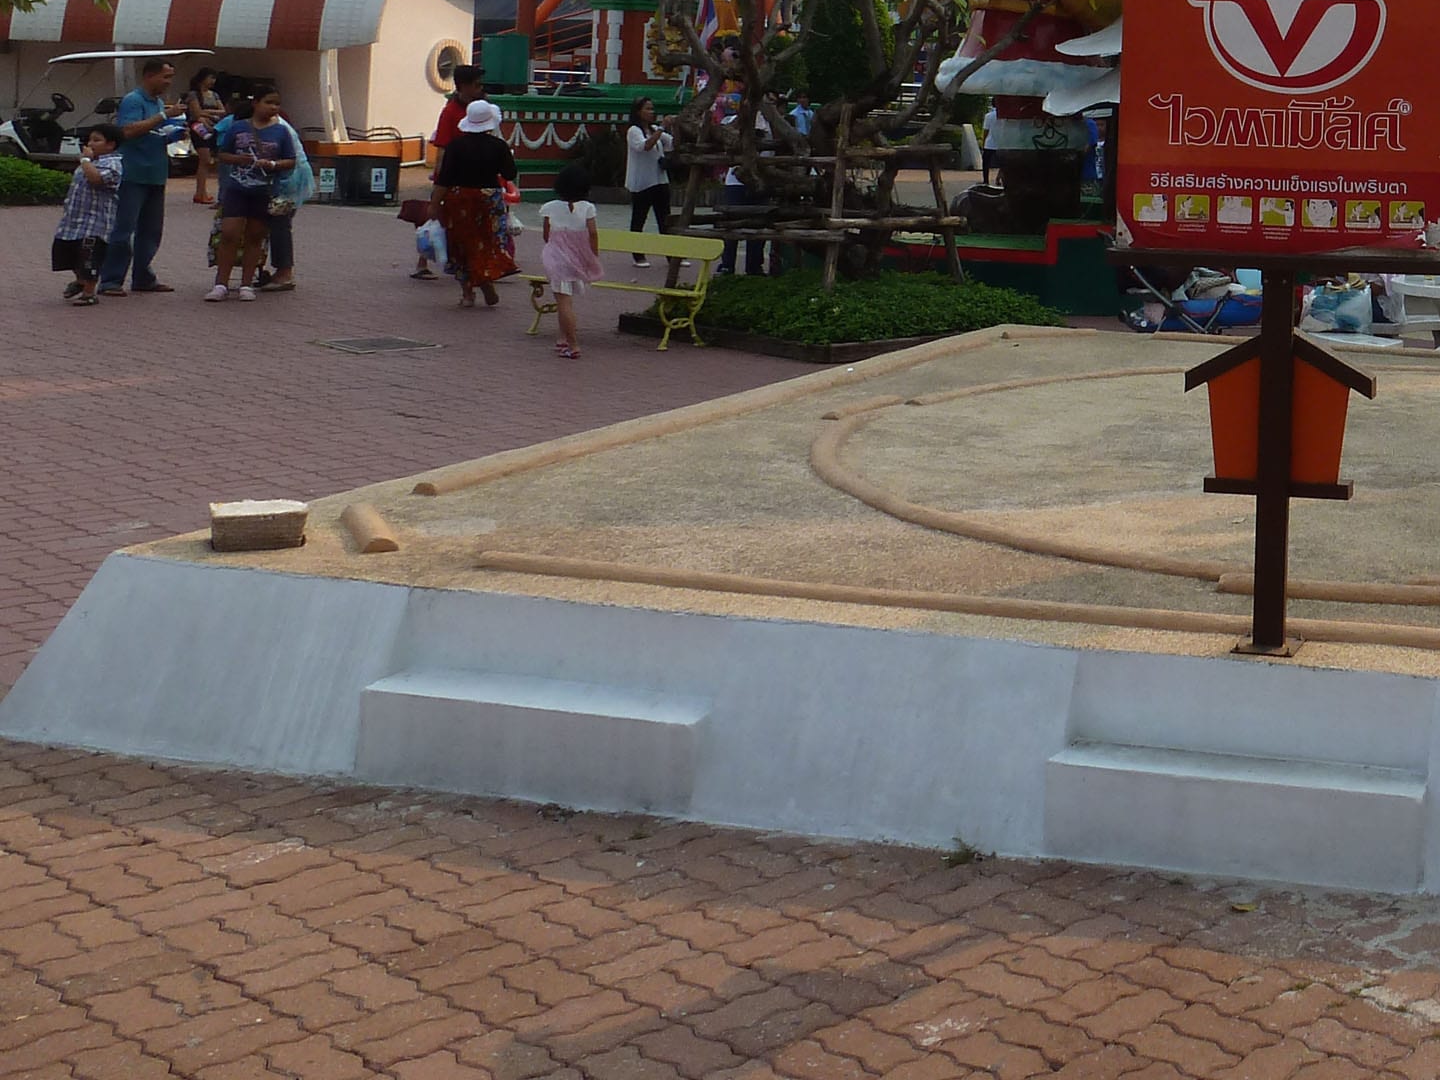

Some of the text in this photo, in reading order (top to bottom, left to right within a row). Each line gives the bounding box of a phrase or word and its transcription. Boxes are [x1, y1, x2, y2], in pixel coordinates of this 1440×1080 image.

[1150, 172, 1408, 195] วิธีเสริมสร้างความแข็งแรงในพริบตา
